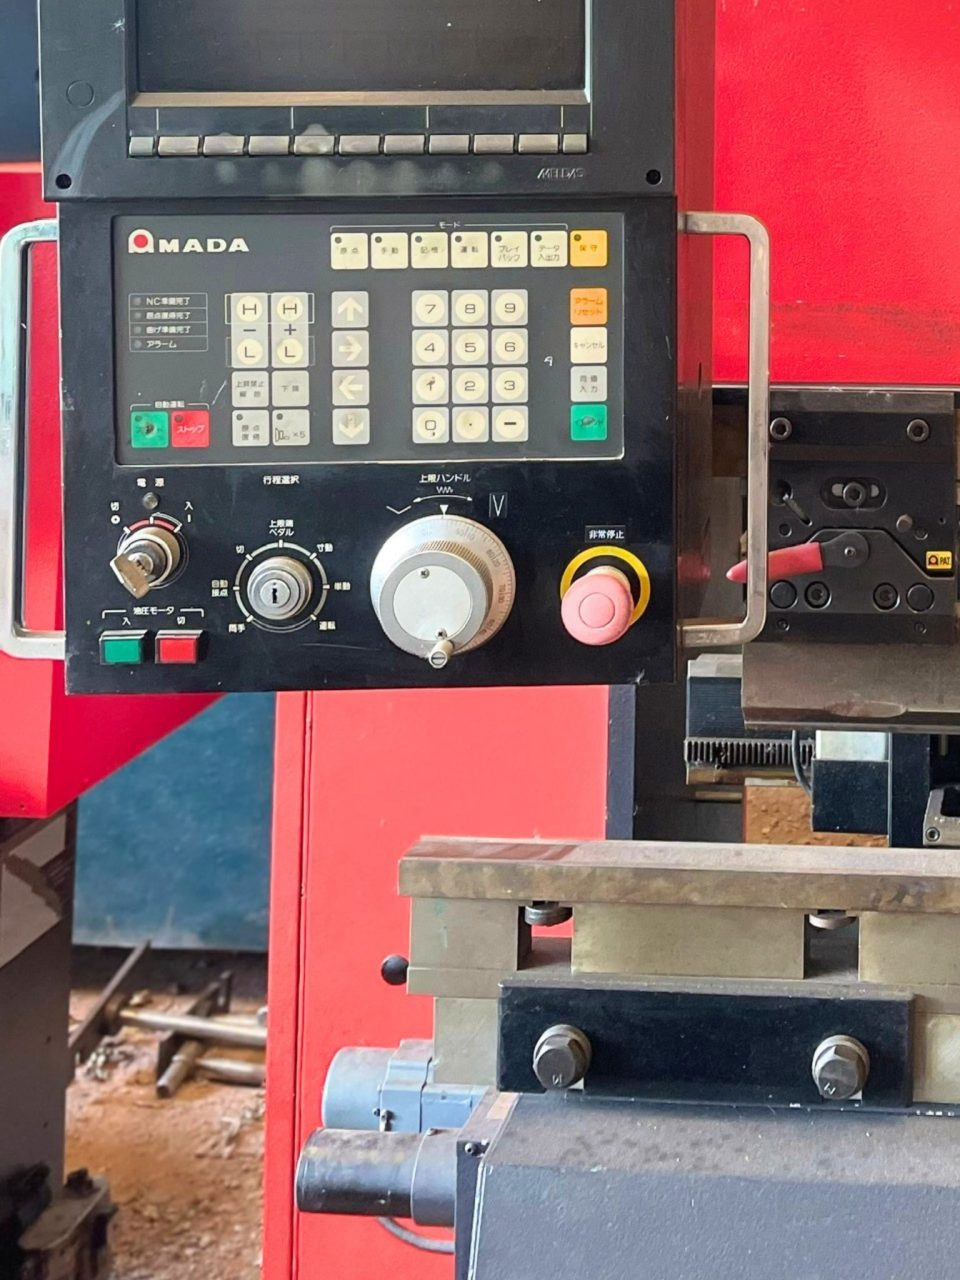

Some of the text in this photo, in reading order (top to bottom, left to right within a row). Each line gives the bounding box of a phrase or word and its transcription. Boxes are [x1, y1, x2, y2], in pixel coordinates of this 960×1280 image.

[128, 229, 250, 254] AMADA
[425, 303, 517, 315] 7 8 9
[147, 340, 177, 349] アラーム
[423, 341, 516, 353] 4 5 6
[464, 380, 476, 392] 2
[503, 380, 516, 391] 3
[136, 477, 165, 488] 電源
[588, 529, 625, 540] 非常停止
